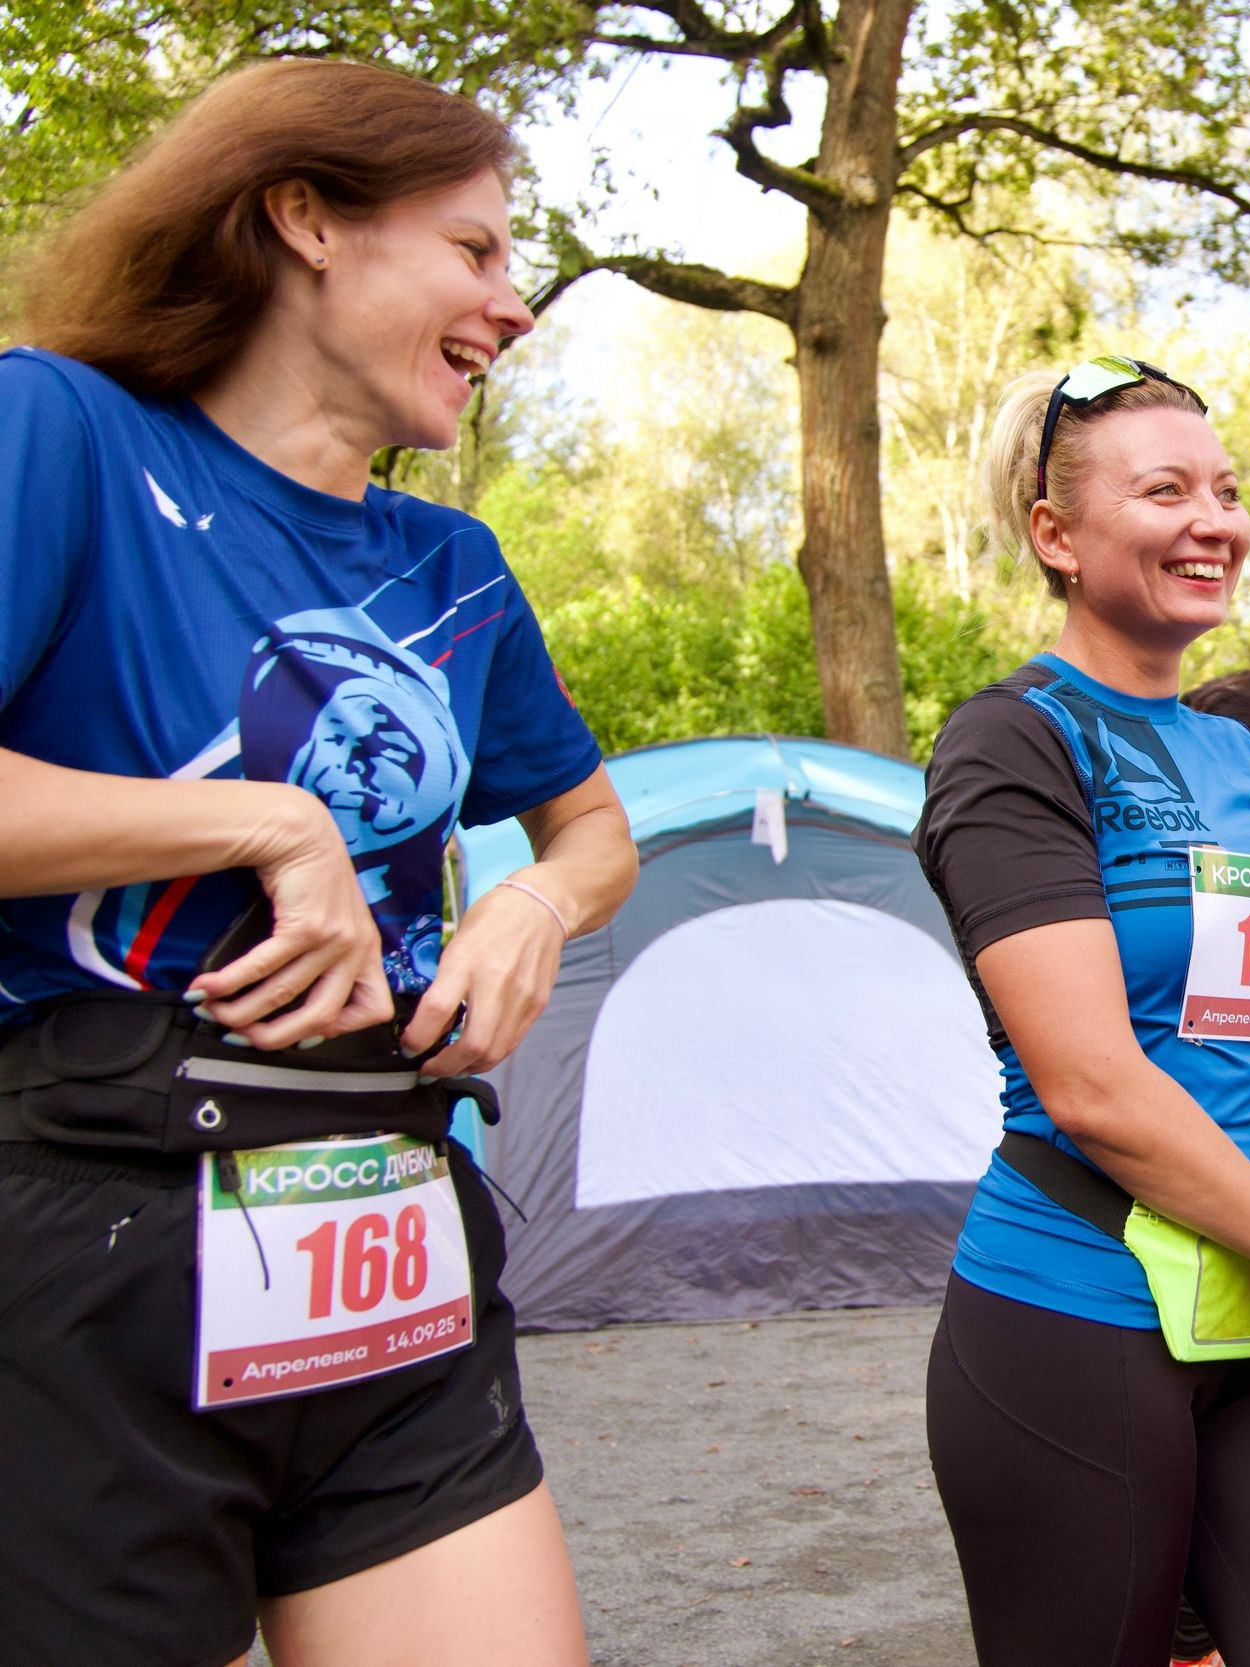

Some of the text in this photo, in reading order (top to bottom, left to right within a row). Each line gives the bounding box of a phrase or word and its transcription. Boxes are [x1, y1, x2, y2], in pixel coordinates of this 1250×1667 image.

[1093, 800, 1211, 835] Reebok
[248, 1145, 438, 1194] КРОСС ДУБКИ
[296, 1203, 428, 1320] 168
[242, 1315, 456, 1382] Апрелевка 14.09.25
